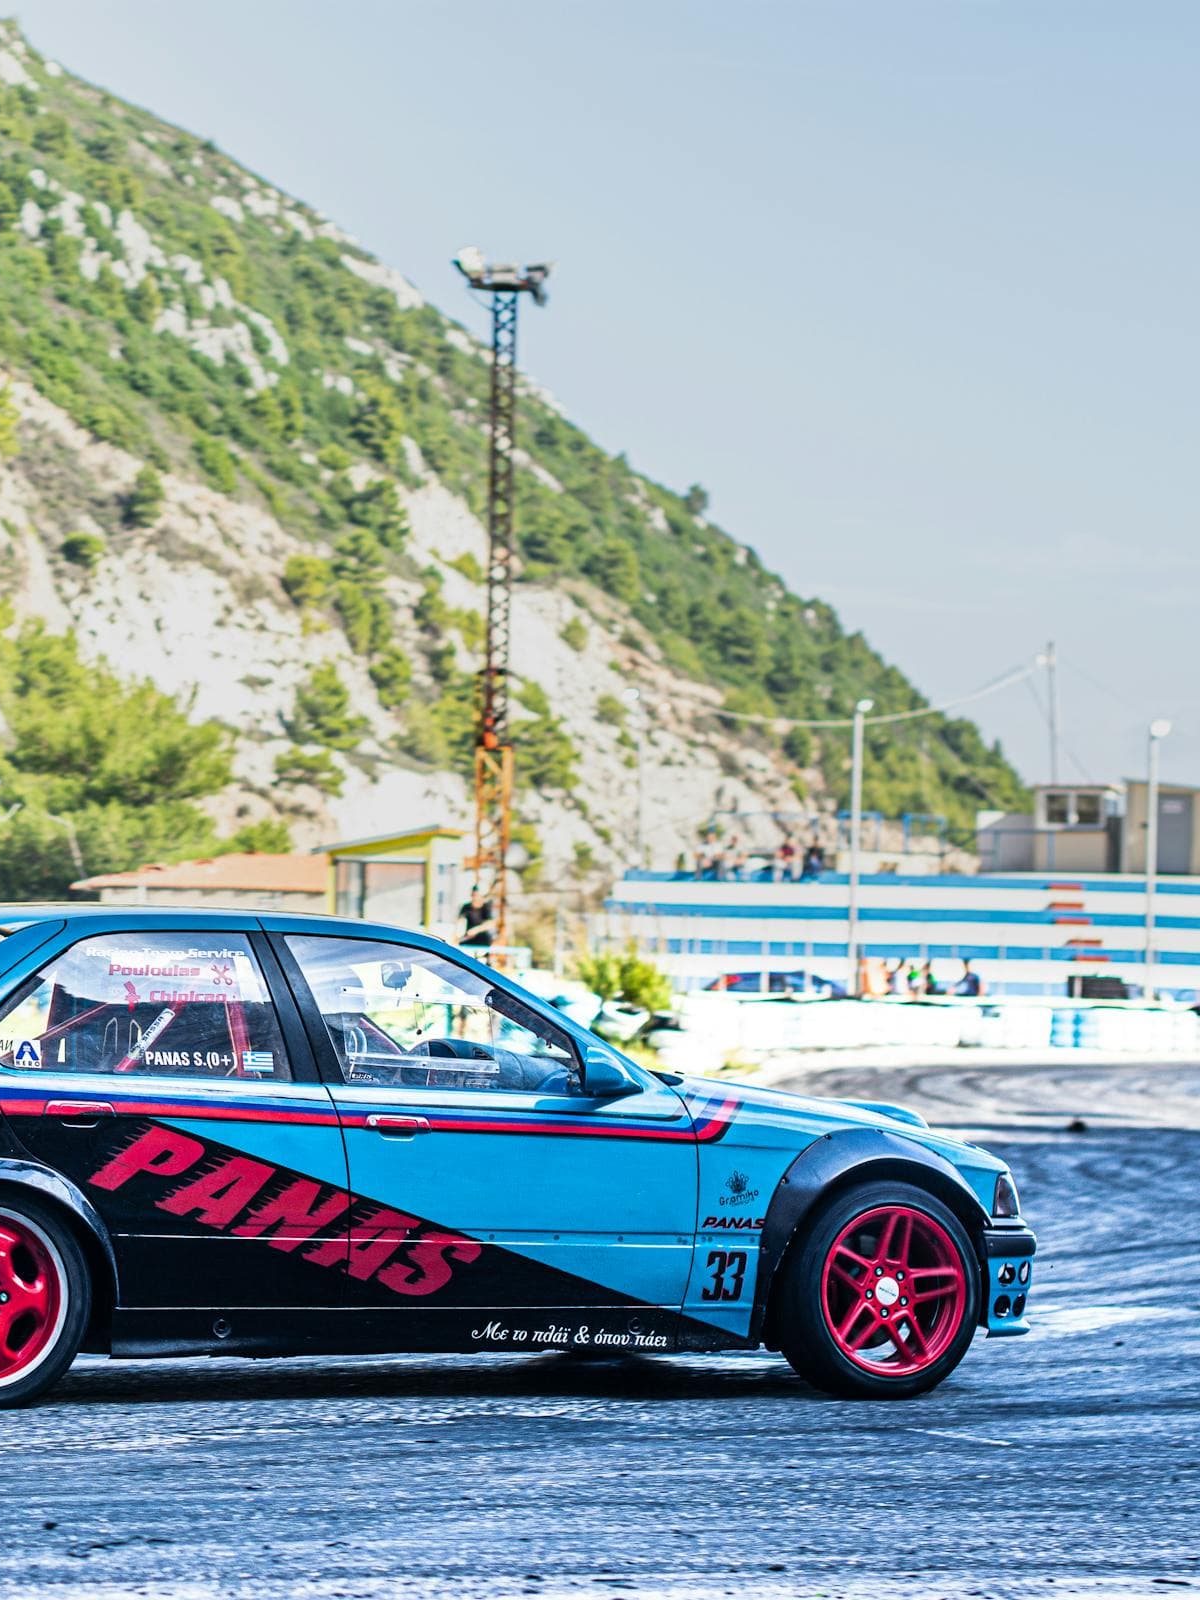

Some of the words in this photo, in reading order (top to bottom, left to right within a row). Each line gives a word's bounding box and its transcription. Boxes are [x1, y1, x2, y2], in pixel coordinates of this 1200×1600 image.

[188, 949, 245, 959] Service
[109, 964, 201, 977] Pouloulas
[145, 1051, 190, 1067] PANAS
[87, 1122, 483, 1297] PANAS
[701, 1216, 765, 1230] PANAS
[701, 1251, 748, 1301] 33
[512, 1329, 528, 1342] το
[573, 1325, 591, 1345] &
